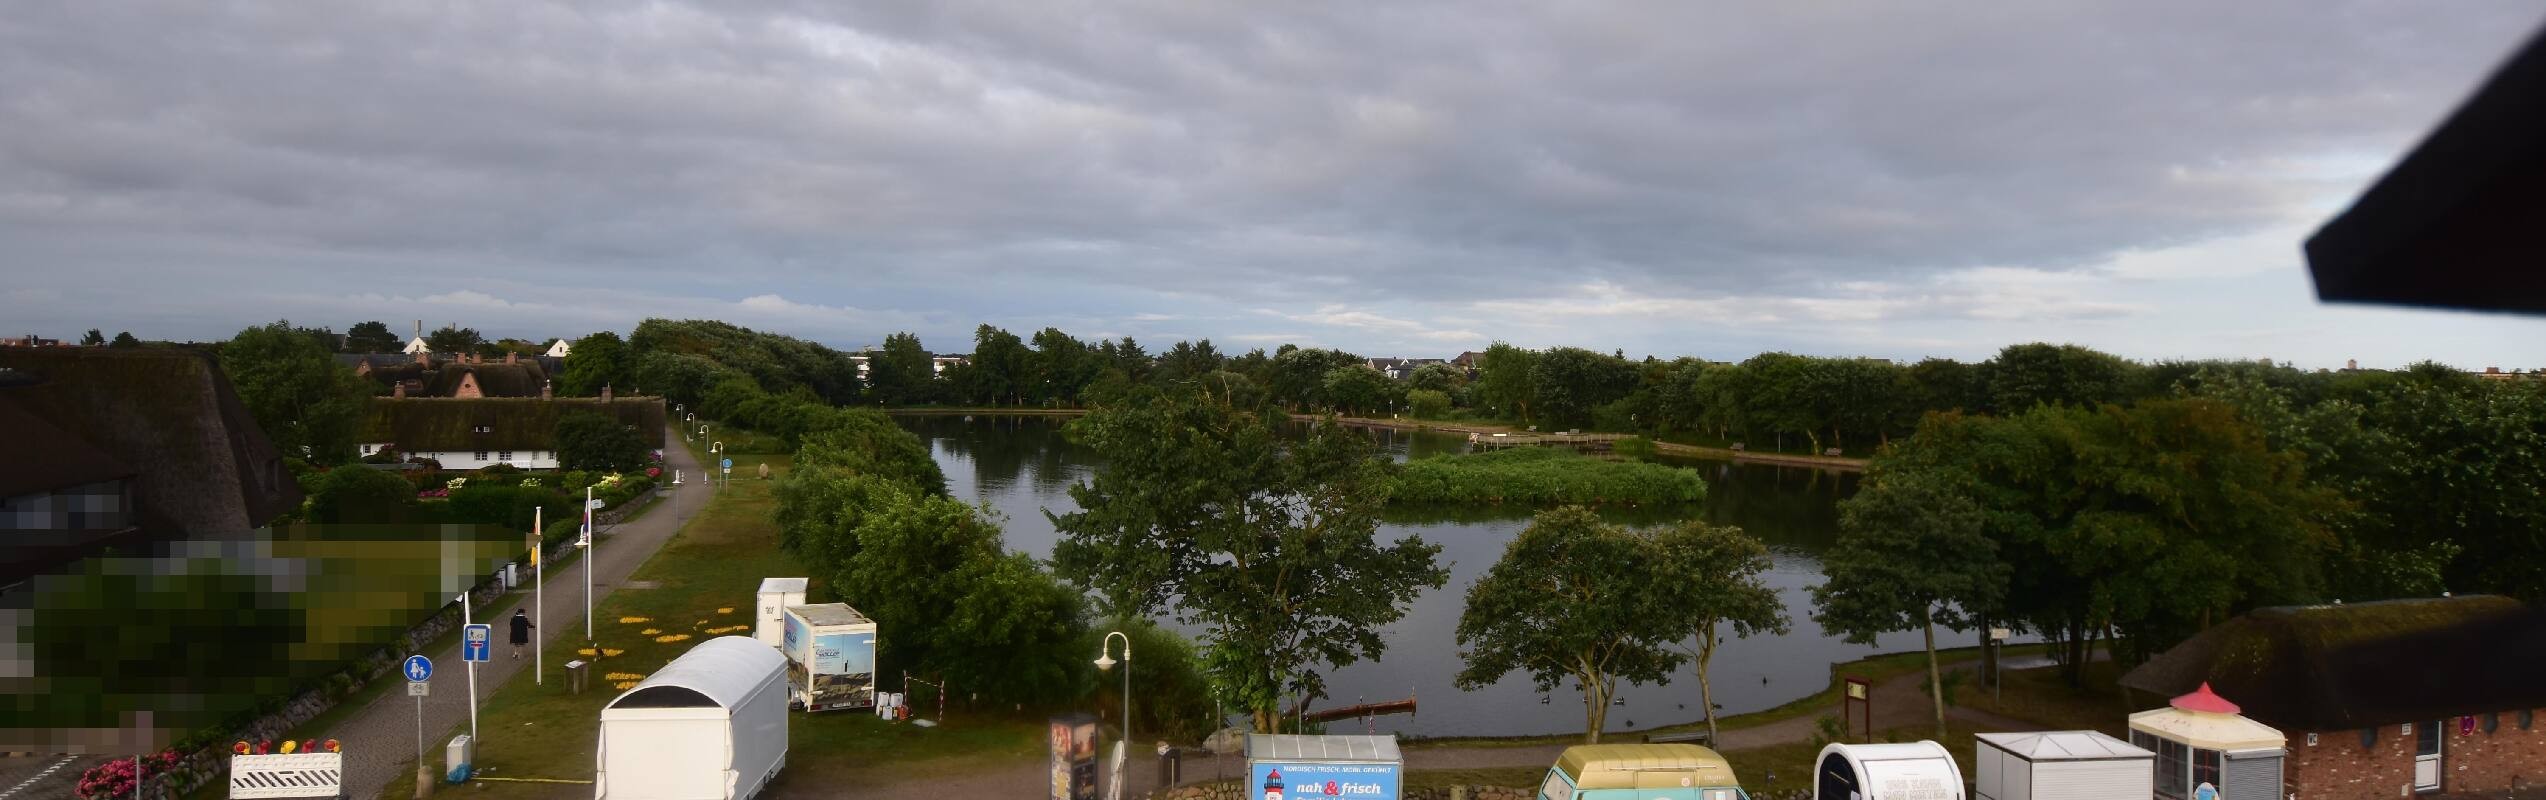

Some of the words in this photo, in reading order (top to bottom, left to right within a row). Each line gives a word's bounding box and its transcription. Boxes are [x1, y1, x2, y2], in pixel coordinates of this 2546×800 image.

[1296, 782, 1322, 793] nah
[1323, 781, 1339, 796] &
[1340, 782, 1381, 796] frisch
